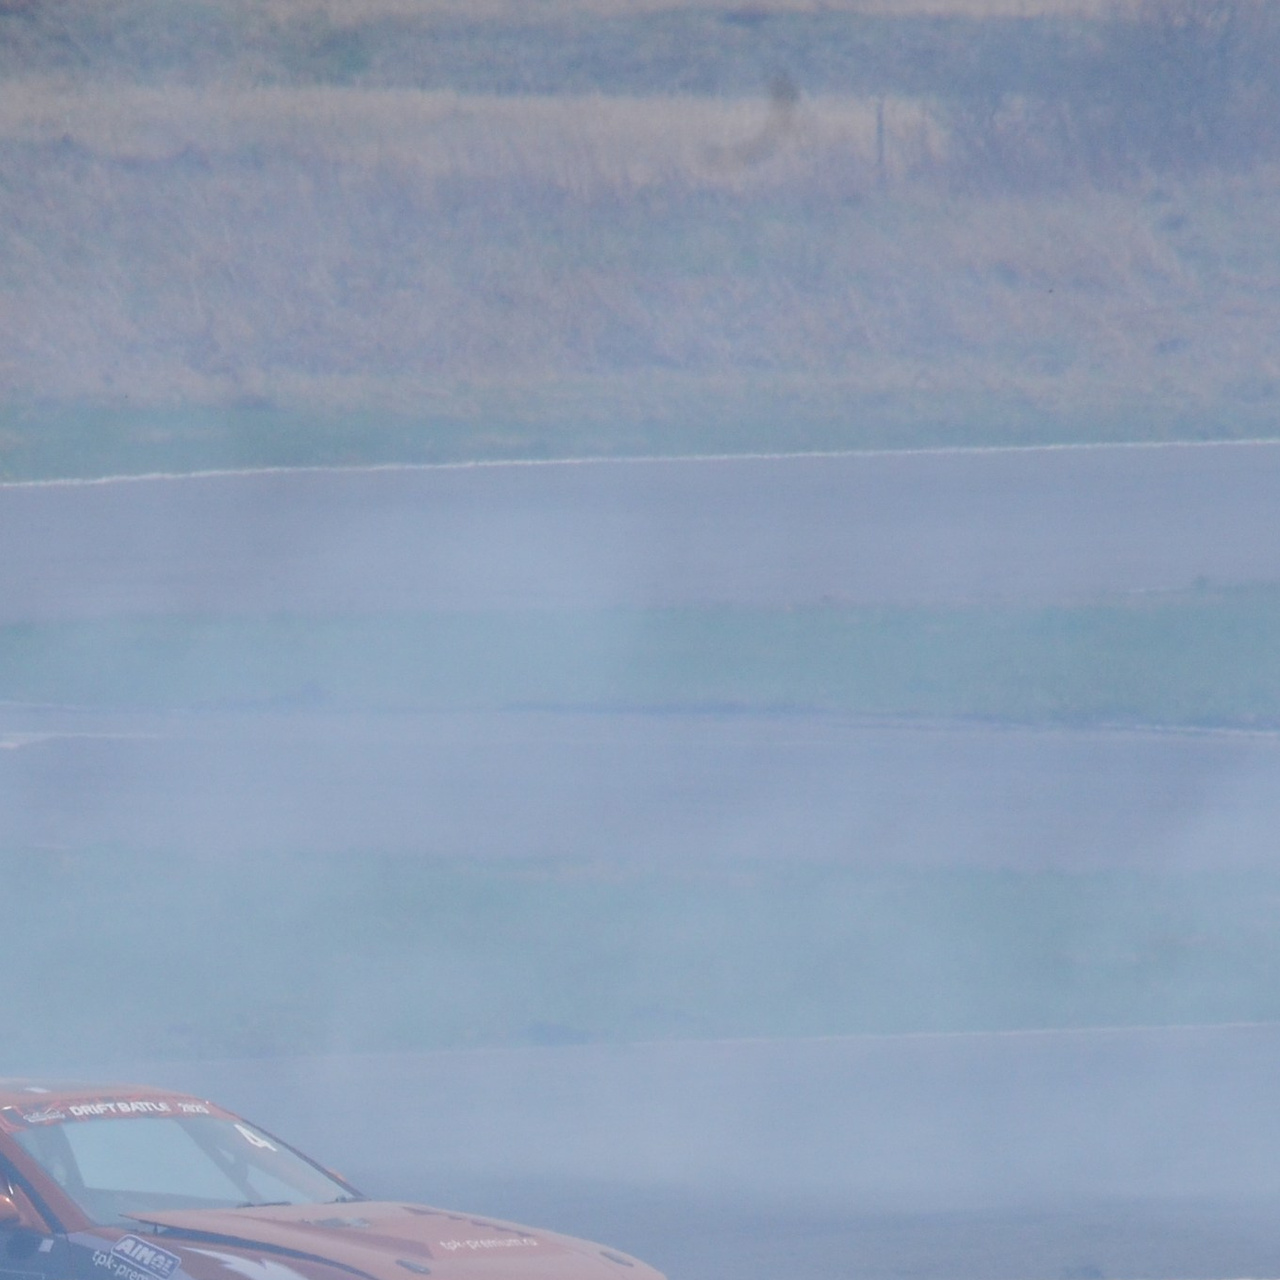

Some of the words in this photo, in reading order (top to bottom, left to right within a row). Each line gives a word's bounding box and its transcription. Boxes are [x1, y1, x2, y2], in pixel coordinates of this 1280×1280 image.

[69, 1103, 118, 1117] DRIFT
[116, 1101, 172, 1114] BATTLE
[234, 1123, 278, 1152] 4
[114, 1238, 174, 1274] AIMOL
